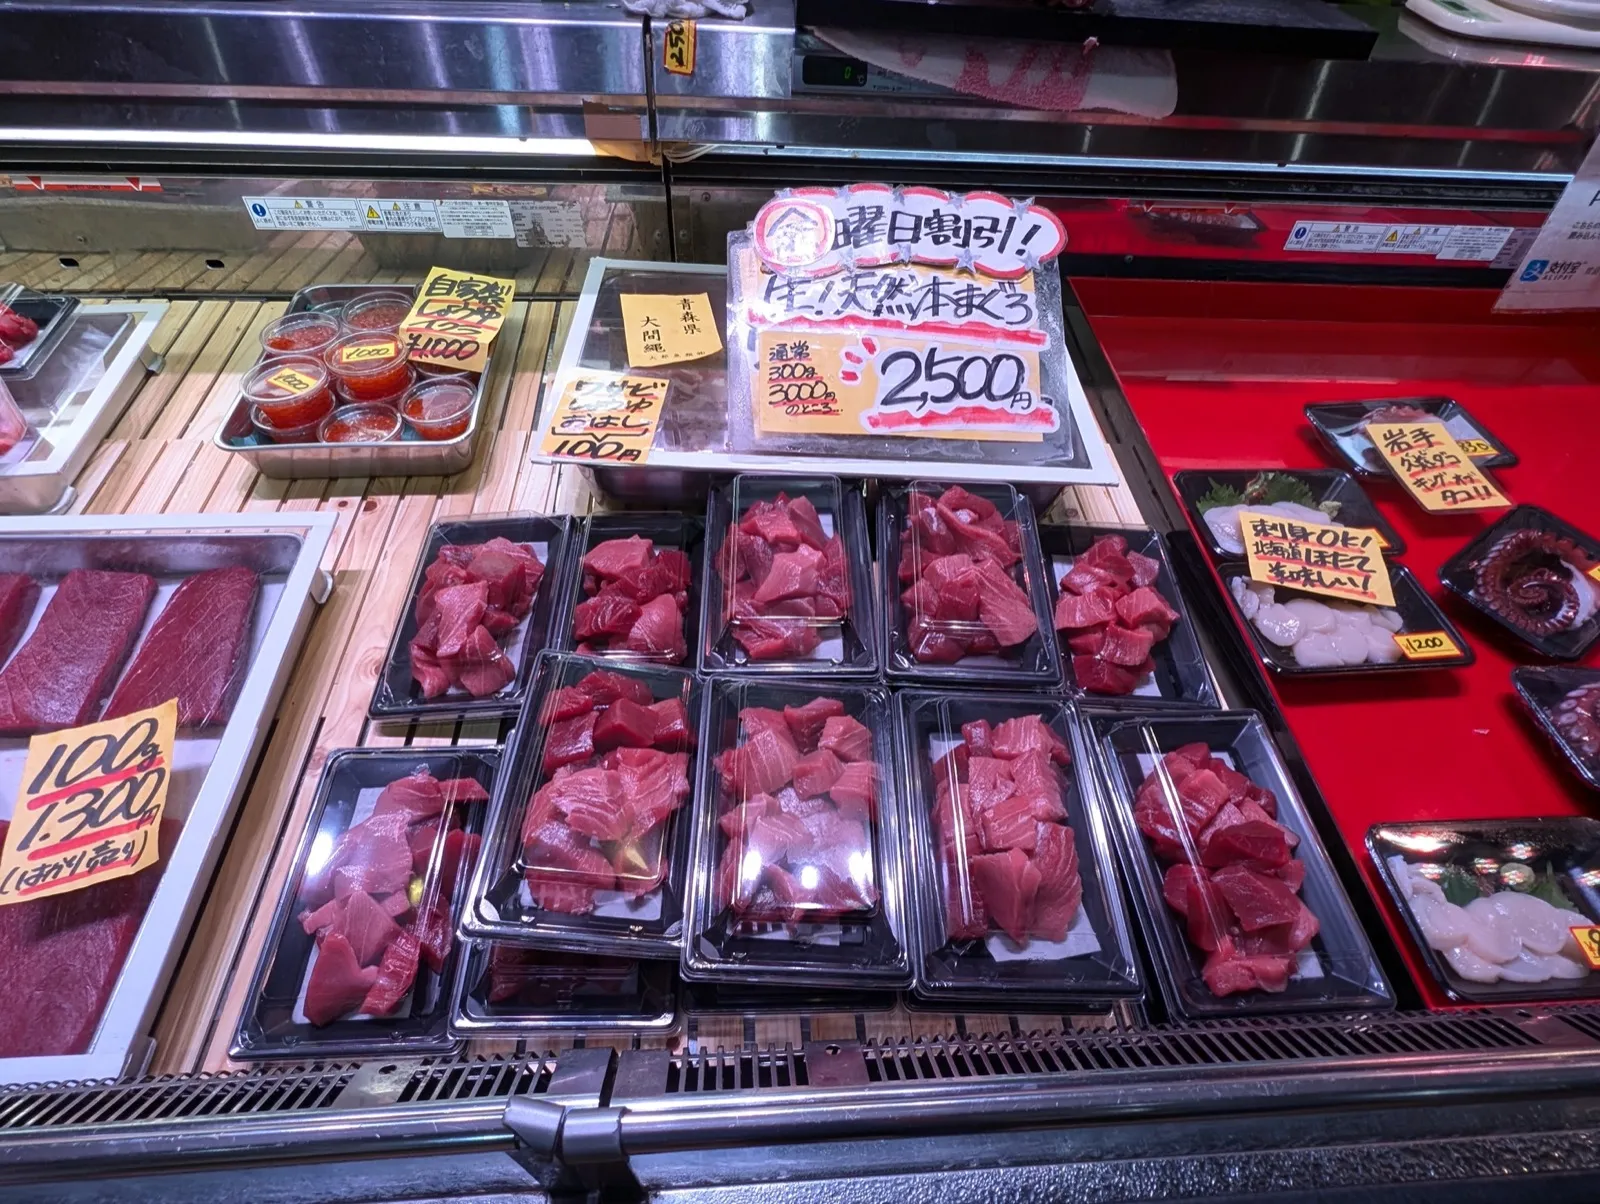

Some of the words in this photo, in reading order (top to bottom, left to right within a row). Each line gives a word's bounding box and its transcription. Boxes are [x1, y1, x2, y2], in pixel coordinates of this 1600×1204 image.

[424, 273, 512, 308] 自家製
[676, 297, 702, 335] 青森県
[768, 340, 811, 362] 通常
[553, 440, 642, 461] 100円
[1382, 427, 1436, 453] 岩手
[1252, 540, 1377, 573] 北海道ほたて
